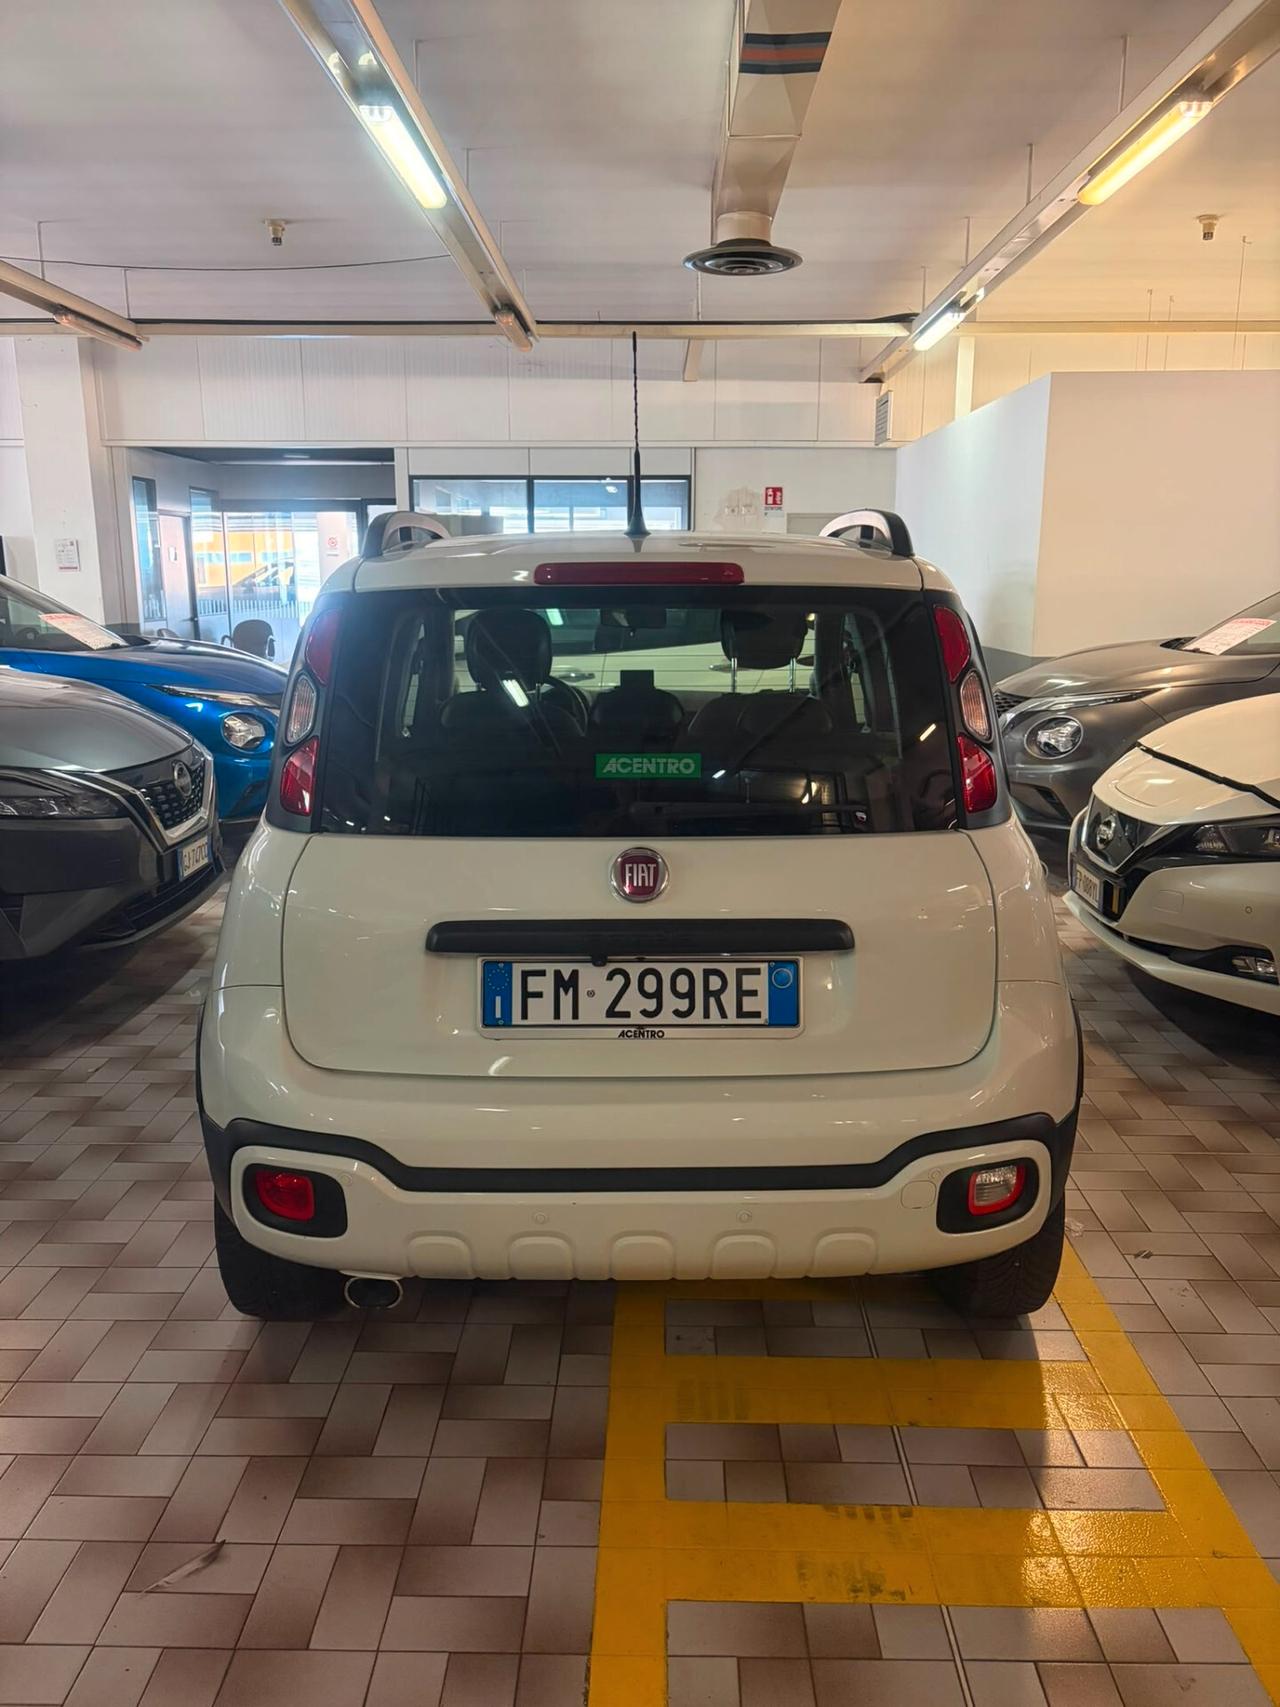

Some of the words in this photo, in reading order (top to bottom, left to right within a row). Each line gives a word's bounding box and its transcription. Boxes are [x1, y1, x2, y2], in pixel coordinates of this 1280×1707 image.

[602, 757, 695, 774] ACENTRO
[625, 863, 657, 888] FIAT
[520, 968, 580, 1021] FM
[605, 967, 763, 1020] 299RE
[618, 1030, 665, 1039] ACENTRO
